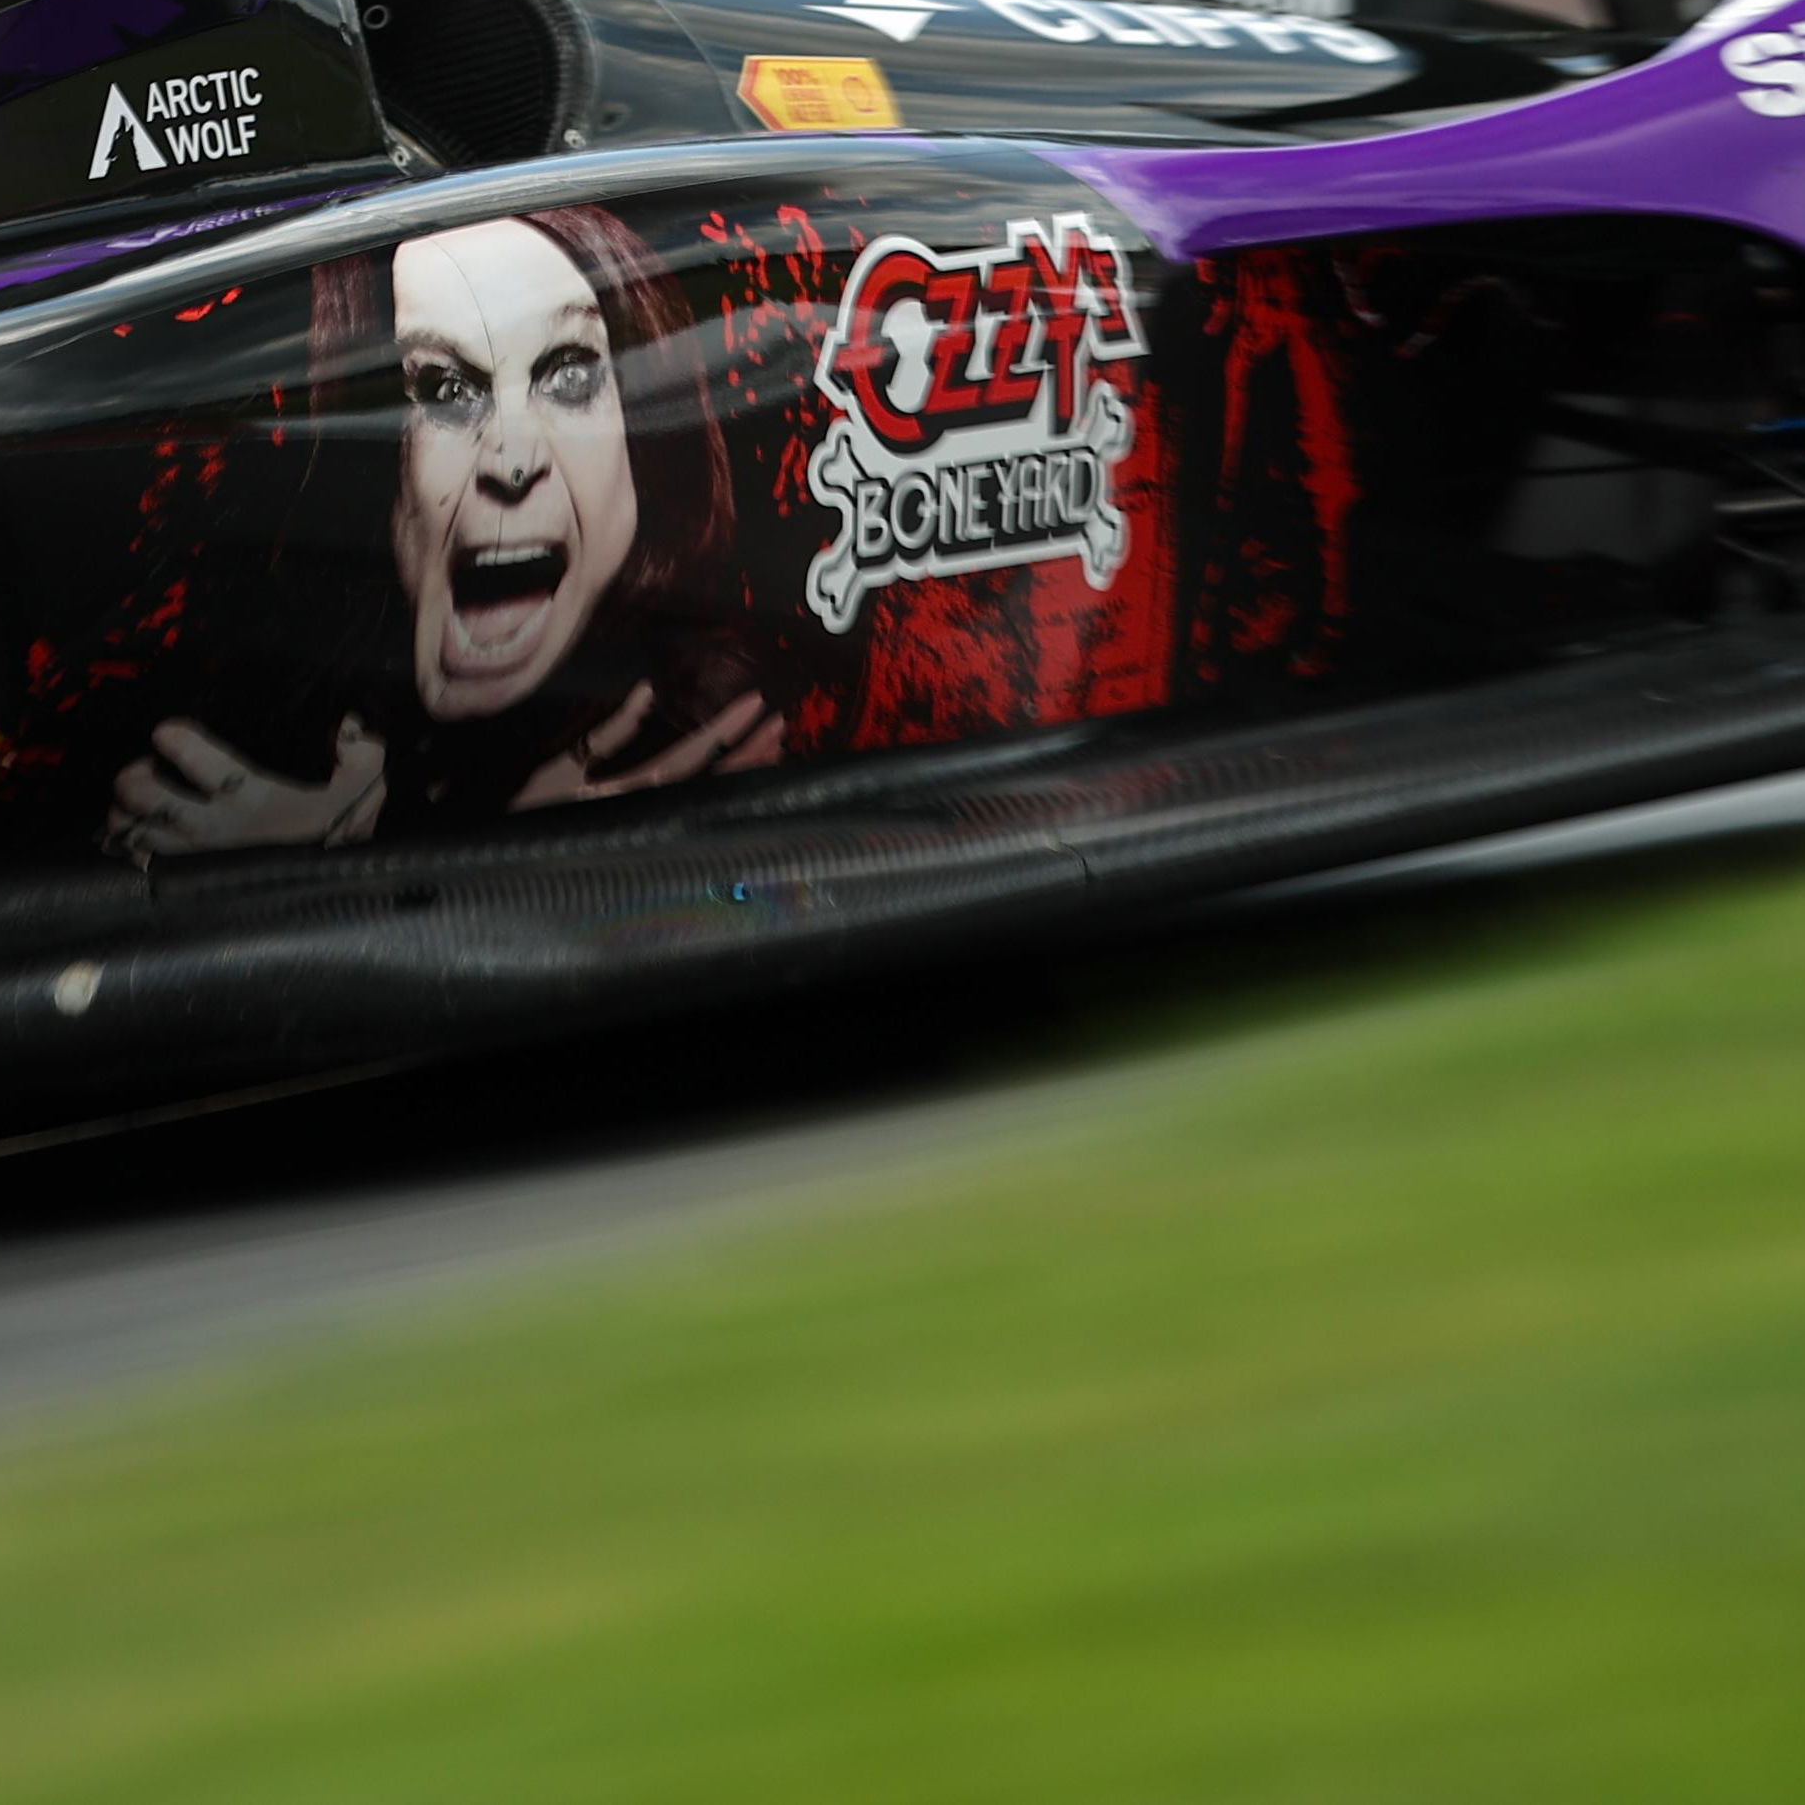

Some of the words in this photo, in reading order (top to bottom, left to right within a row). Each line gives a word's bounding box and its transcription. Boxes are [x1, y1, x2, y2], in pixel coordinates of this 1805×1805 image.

[146, 67, 264, 123] ARCTIC
[1719, 23, 1805, 118] S
[163, 114, 257, 165] WOLF
[854, 450, 1098, 560] BONEYARD
